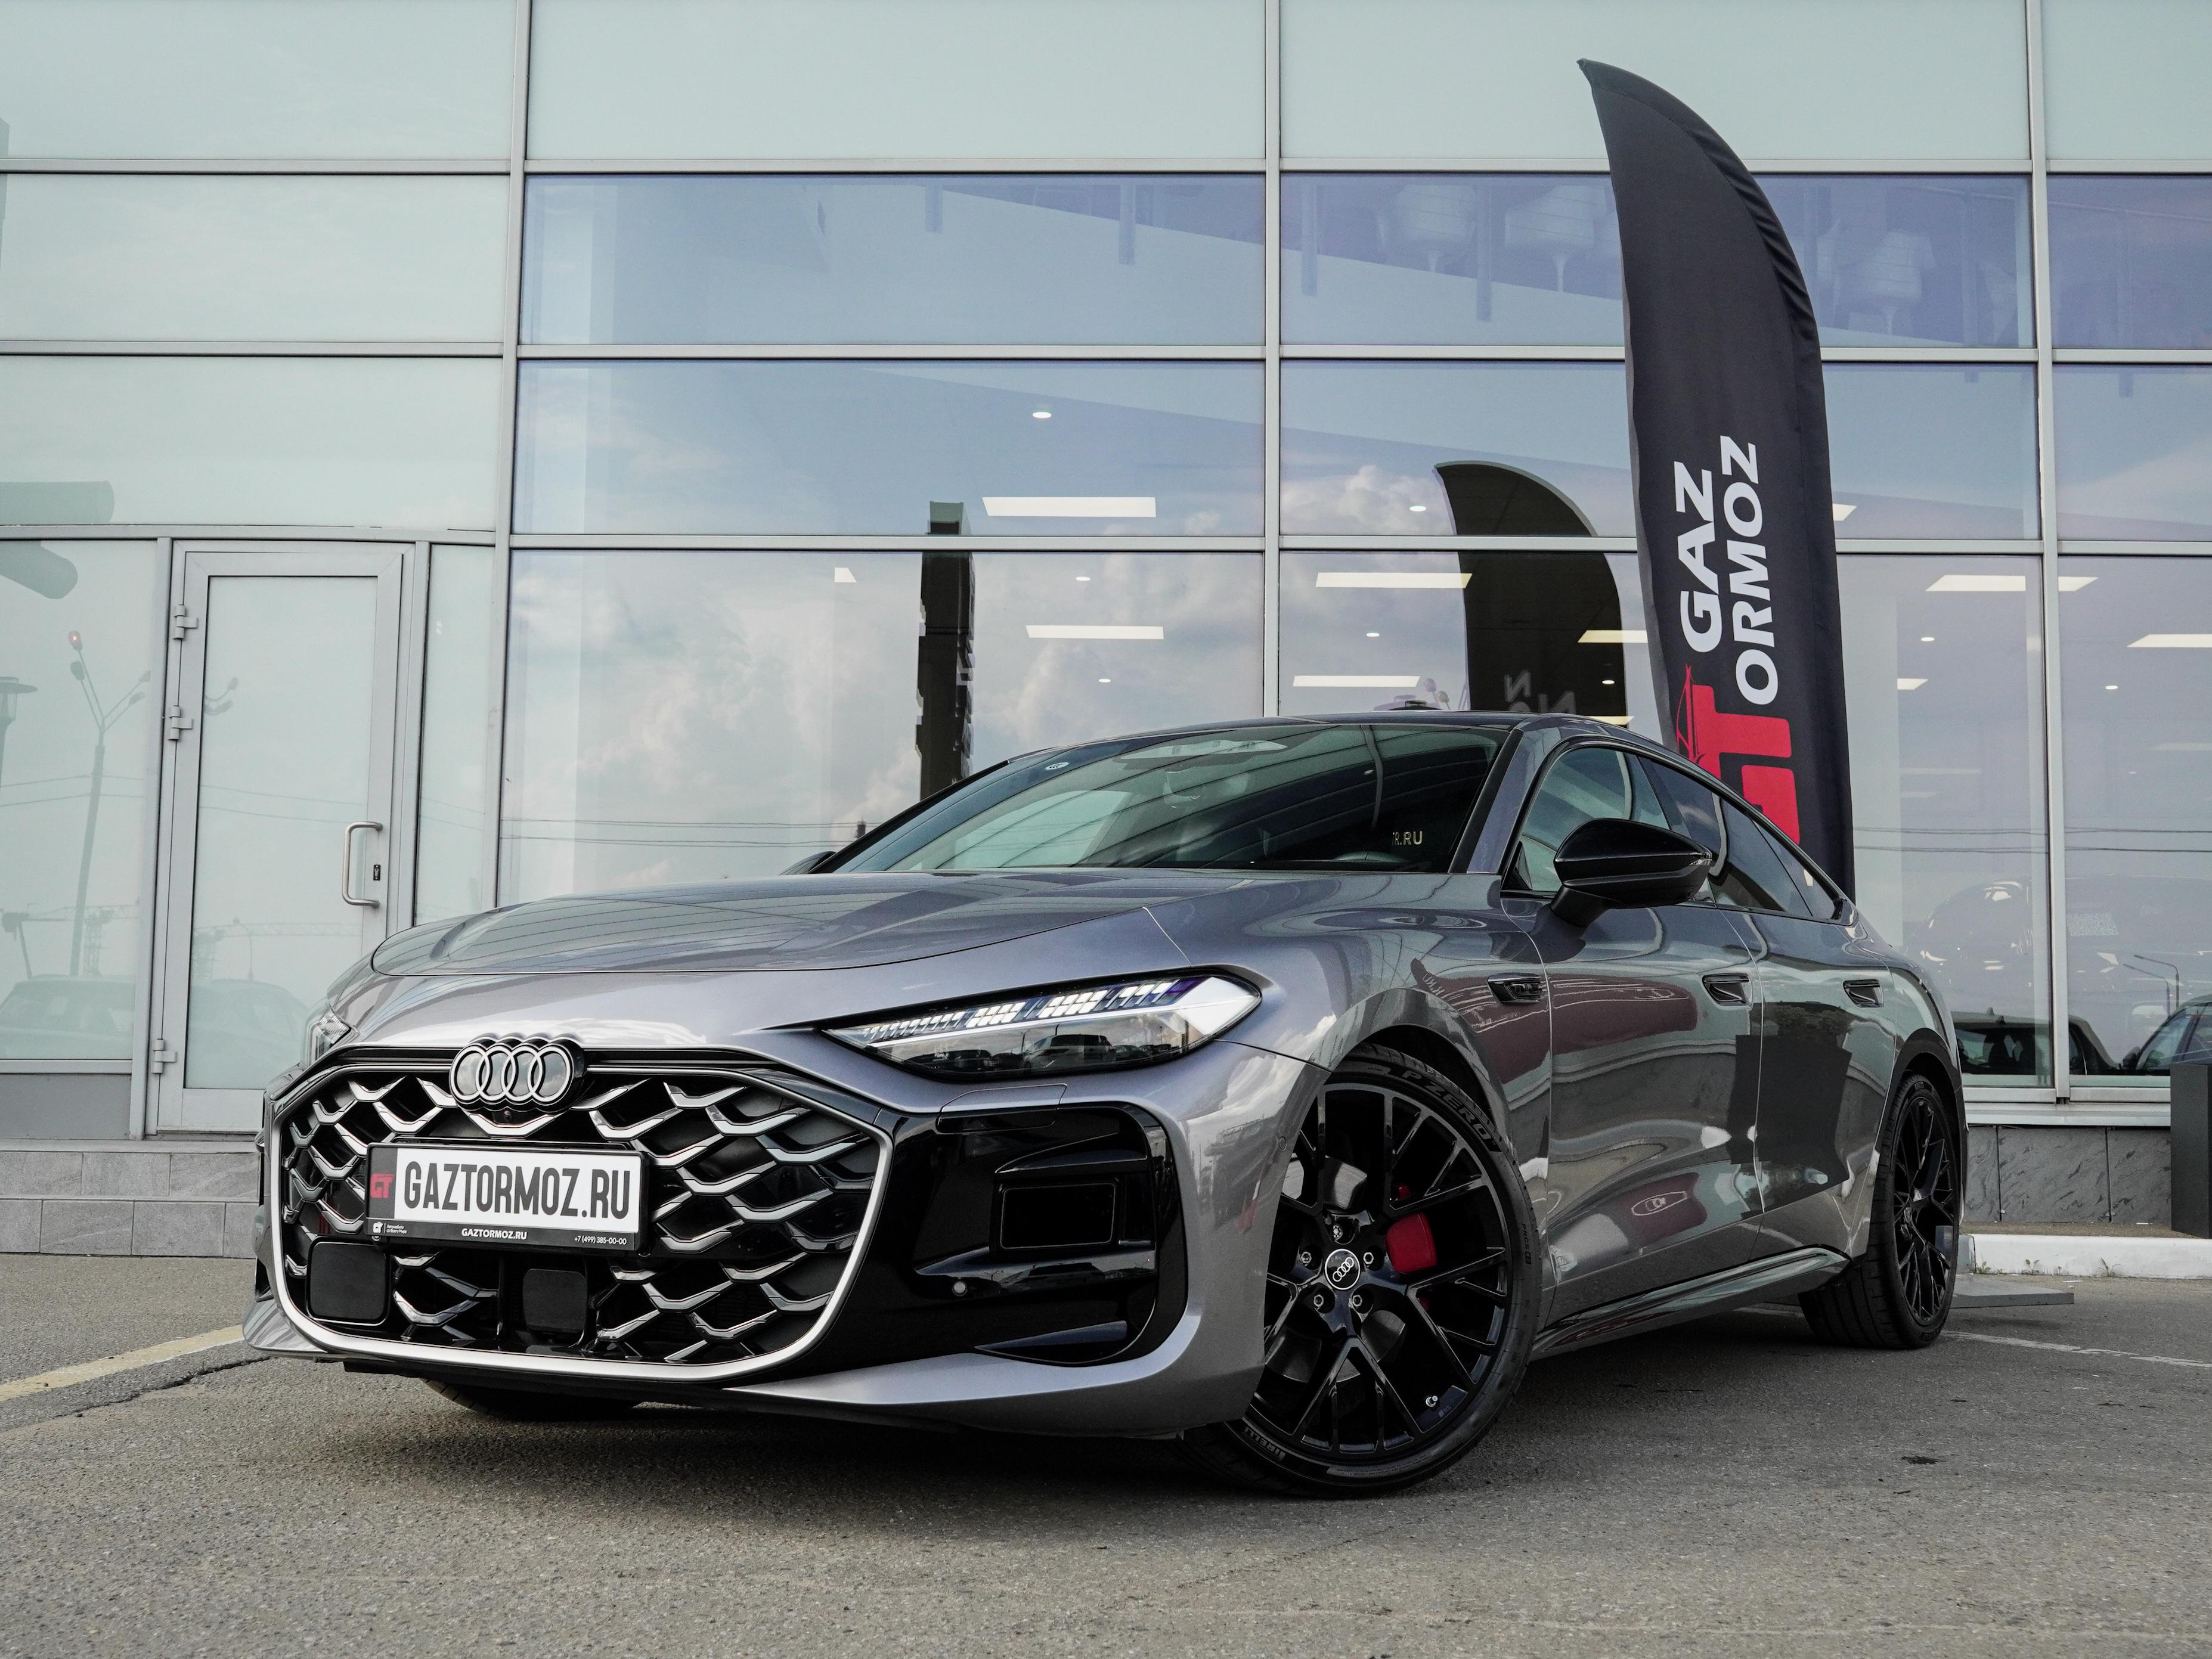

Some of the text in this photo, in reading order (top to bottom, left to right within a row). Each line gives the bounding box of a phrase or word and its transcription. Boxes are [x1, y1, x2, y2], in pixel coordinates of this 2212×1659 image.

[1674, 460, 1722, 653] GAZ
[1720, 435, 1779, 705] ORMOZ
[1402, 1069, 1492, 1140] P ZERO
[404, 1161, 631, 1220] GAZTORMOZ.RU
[461, 1228, 527, 1241] GAZTORMOZ.RU
[582, 1235, 596, 1244] (499)
[596, 1236, 627, 1245] 385-00-00
[1243, 1426, 1287, 1461] PIRELLI
